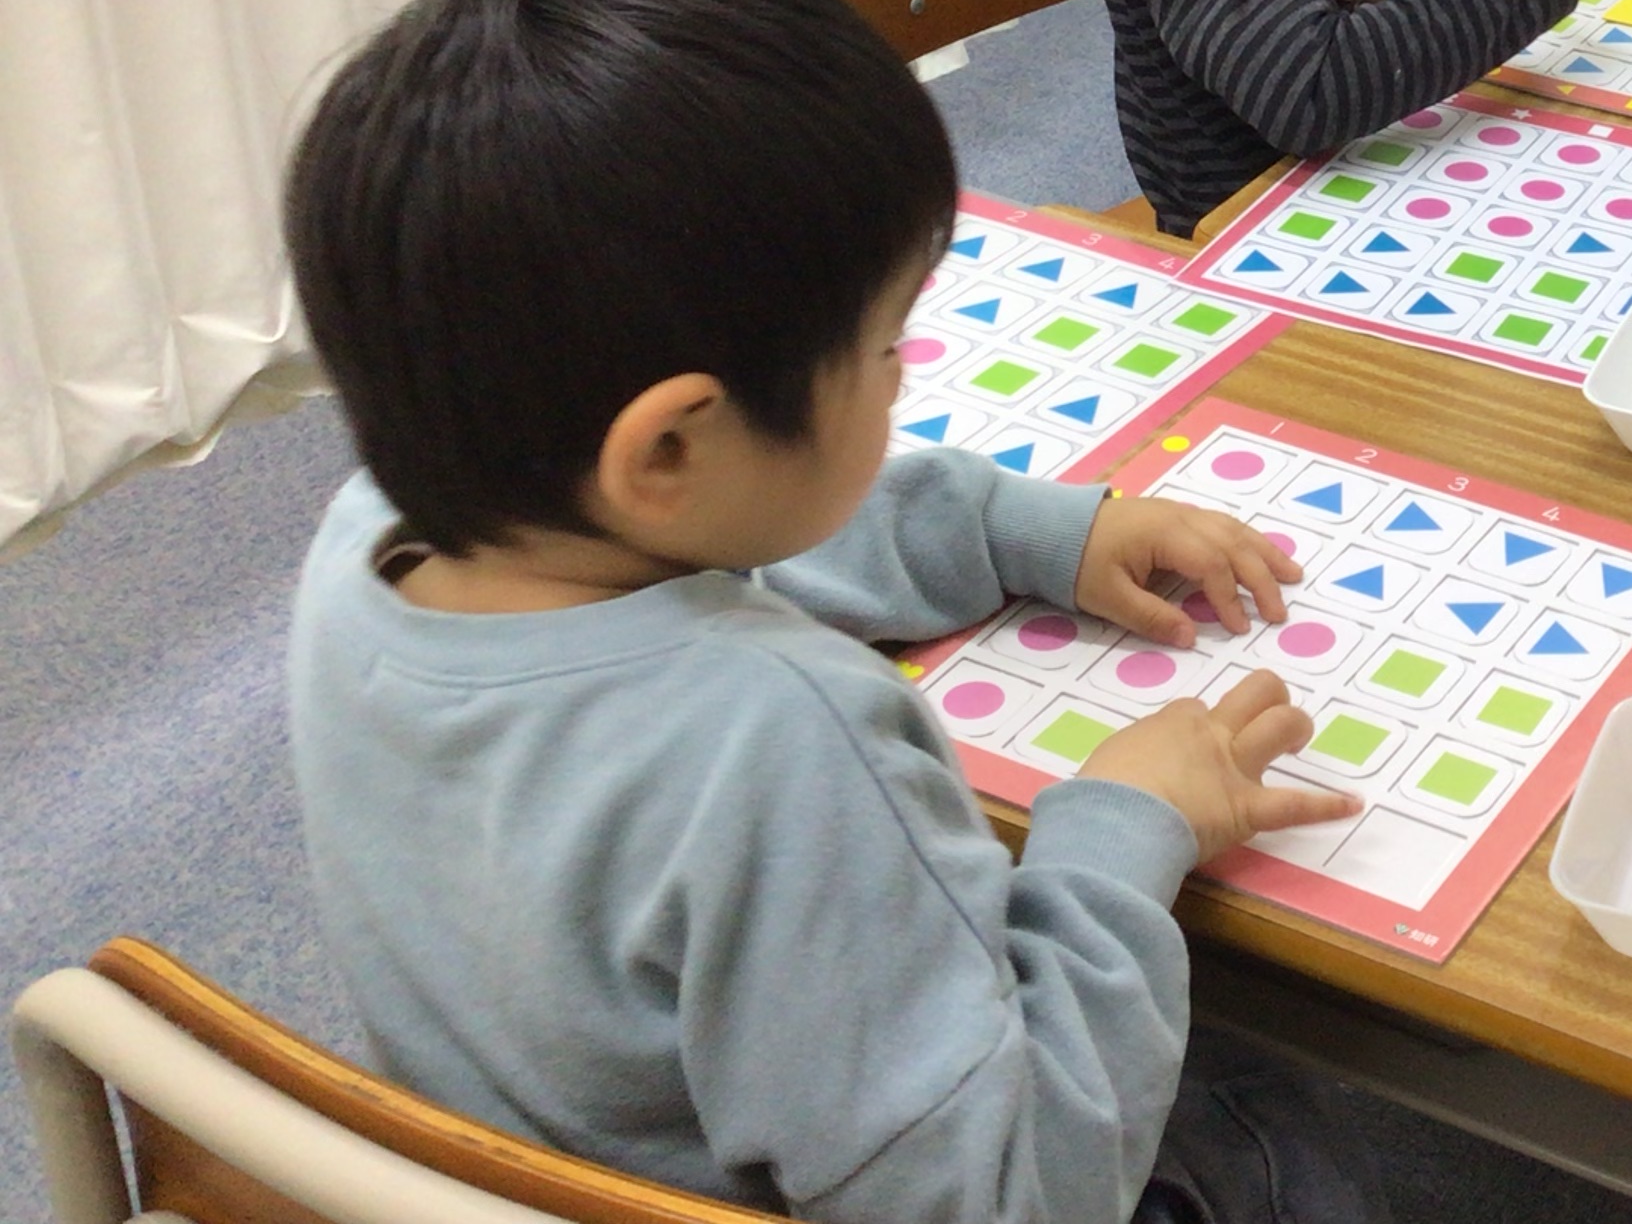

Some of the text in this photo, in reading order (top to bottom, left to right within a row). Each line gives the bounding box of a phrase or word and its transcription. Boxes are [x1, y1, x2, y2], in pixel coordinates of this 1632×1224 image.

[1006, 210, 1177, 270] 2 3 4
[1270, 421, 1286, 436] 1
[1354, 448, 1379, 464] 2
[1447, 476, 1470, 493] 3
[1541, 506, 1561, 522] 4
